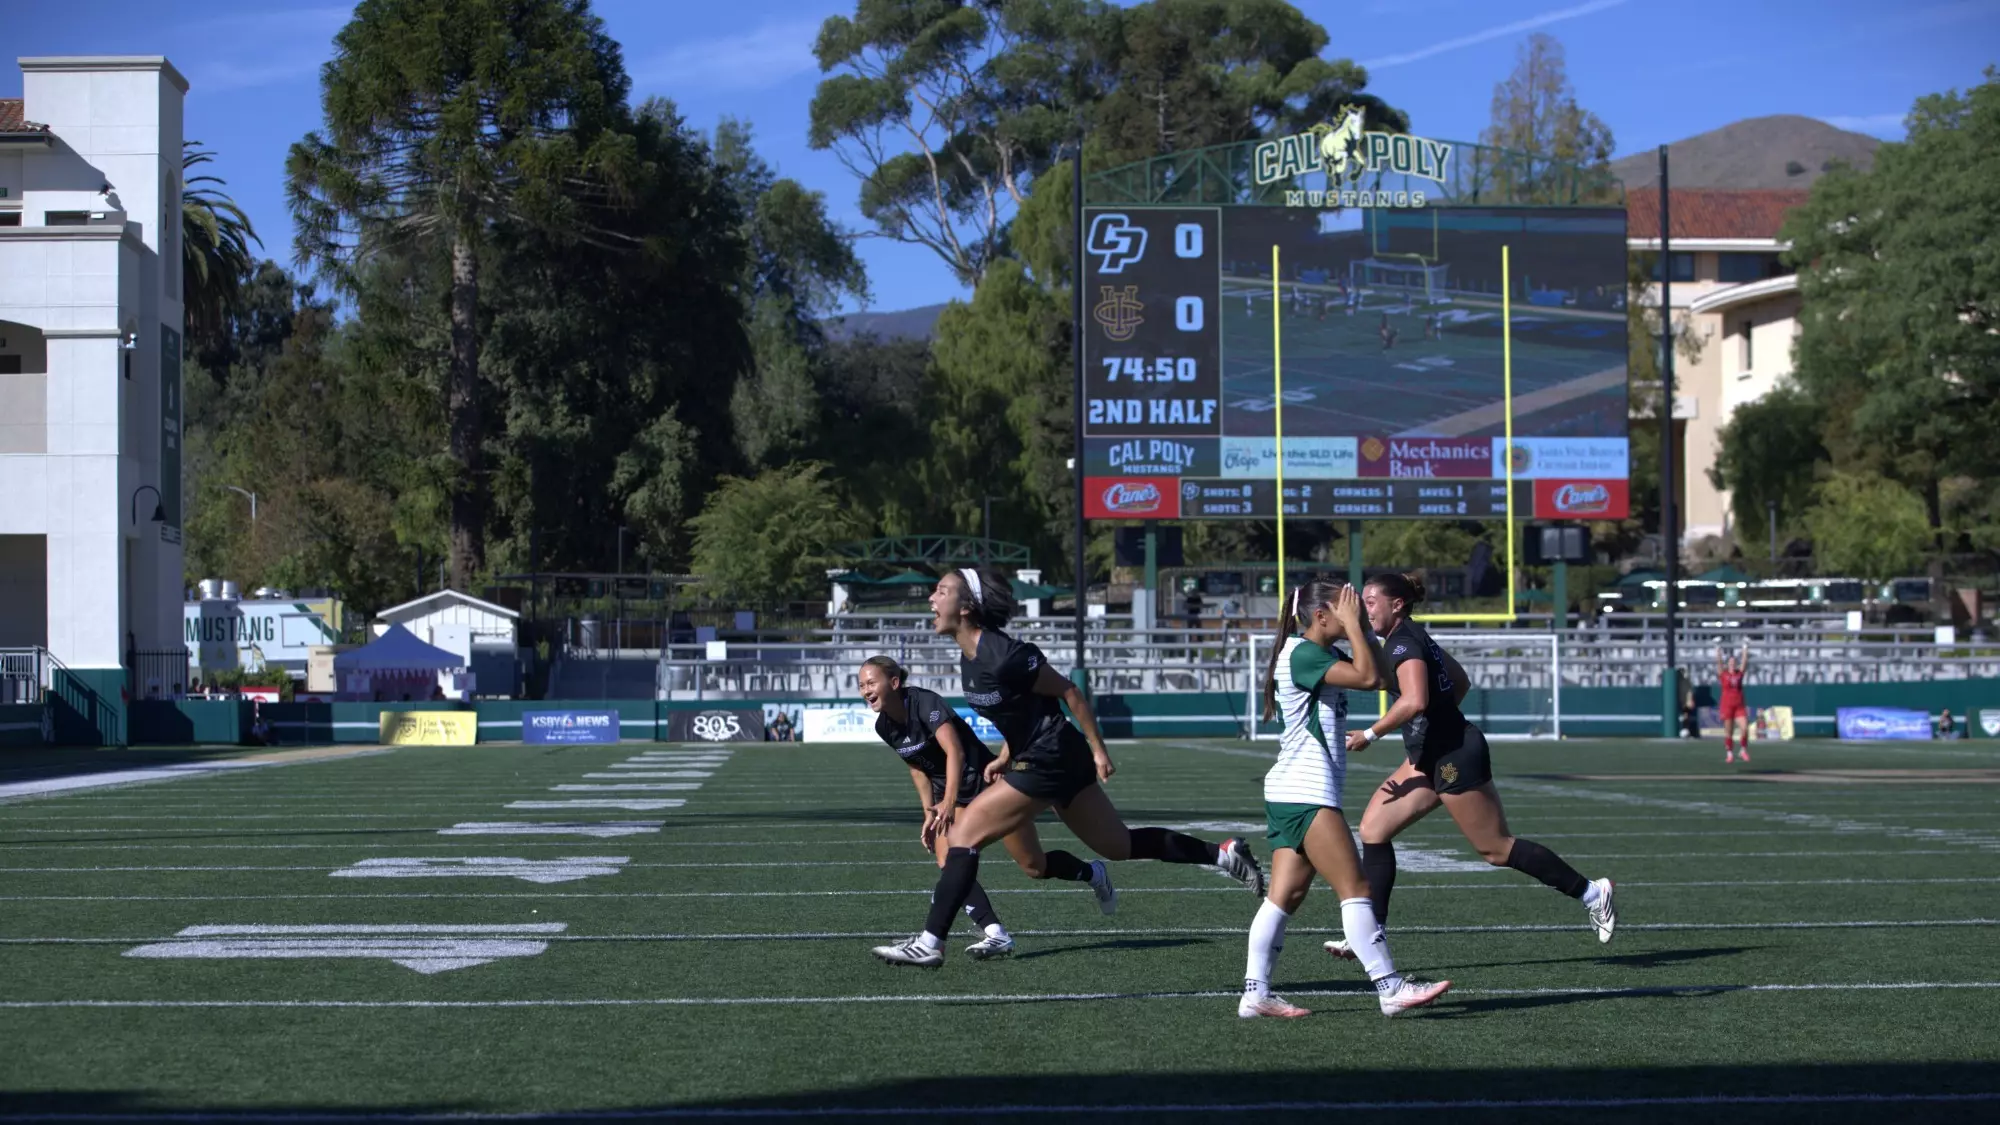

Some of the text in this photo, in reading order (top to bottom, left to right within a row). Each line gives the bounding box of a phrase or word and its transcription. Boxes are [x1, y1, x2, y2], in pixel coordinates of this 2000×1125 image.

[1255, 131, 1452, 185] CAL POLY
[1285, 190, 1425, 208] MUSTANGS
[1175, 223, 1203, 258] 0
[1175, 296, 1203, 331] 0
[1102, 357, 1196, 382] 74:50
[1088, 399, 1217, 424] 2ND HALF
[1109, 440, 1195, 467] CAL POLY
[1389, 441, 1490, 460] Mechanics
[1122, 464, 1182, 474] MUSTANGS
[1389, 459, 1437, 478] Bank
[185, 616, 275, 642] MUSTANG
[576, 715, 610, 727] NEWS
[693, 715, 740, 735] 805
